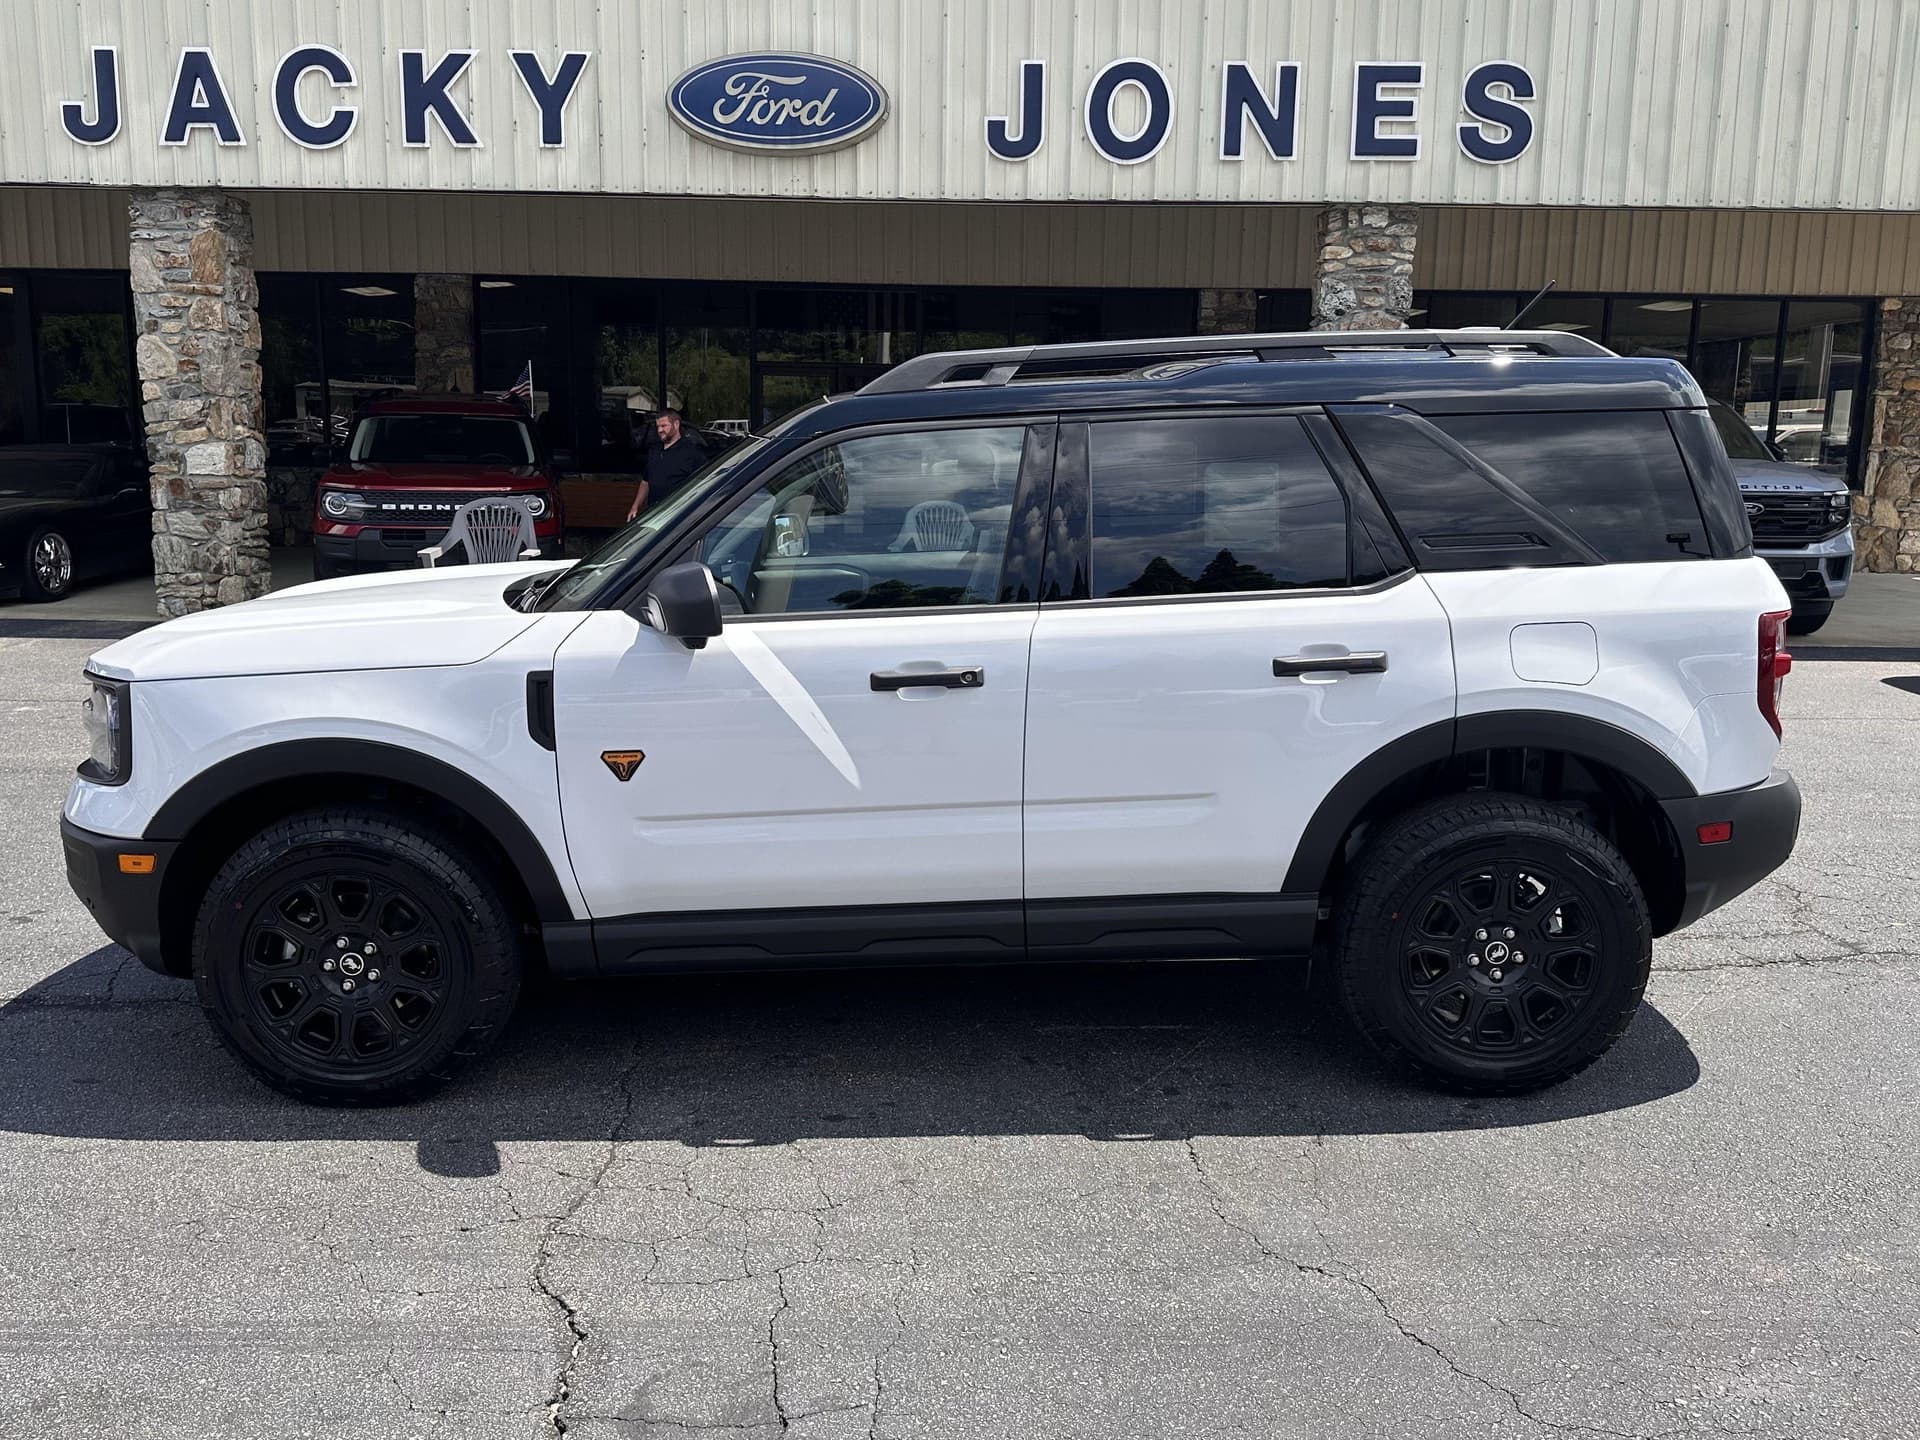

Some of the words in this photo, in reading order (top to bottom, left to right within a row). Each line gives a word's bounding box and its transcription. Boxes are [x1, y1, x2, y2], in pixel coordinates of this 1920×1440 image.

[60, 44, 592, 150] JACKY
[984, 57, 1536, 165] JONES
[712, 72, 839, 127] Ford
